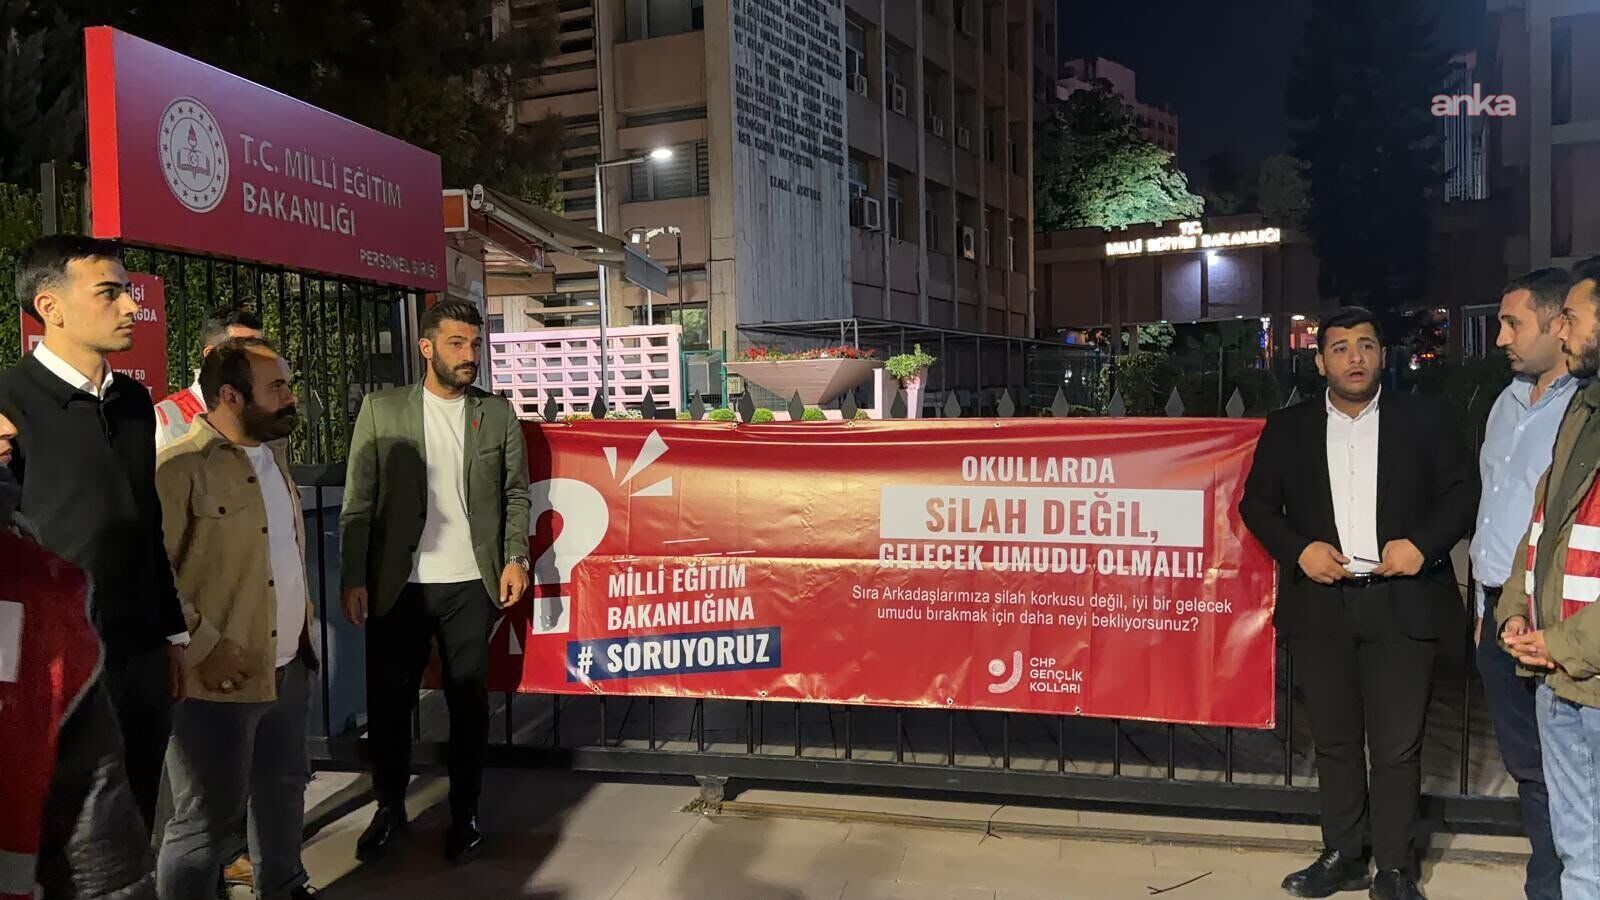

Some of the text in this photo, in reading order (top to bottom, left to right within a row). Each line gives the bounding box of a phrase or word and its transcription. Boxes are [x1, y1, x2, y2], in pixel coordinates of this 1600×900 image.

[240, 134, 279, 174] T.C.
[343, 166, 402, 209] EĞİTİM
[243, 182, 356, 236] BAKANLIĞI
[360, 248, 411, 274] PERSONEL
[962, 455, 1115, 484] OKULLARDA
[879, 543, 1204, 579] GELECEK UMUDU OLMALI!
[608, 560, 746, 598] MİLLİ EĞİTİM
[607, 593, 755, 631] BAKANLIĞINA
[852, 585, 1232, 615] Sıra Arkadaşlarımıza silah korkusu değil, iyi bir gelecek
[877, 606, 1199, 632] umudu bırakmak için daha neyi bekliyorsunuz?
[607, 633, 770, 674] SORUYORUZ
[1029, 657, 1056, 668] CHP
[1029, 682, 1081, 694] KOLLARI
